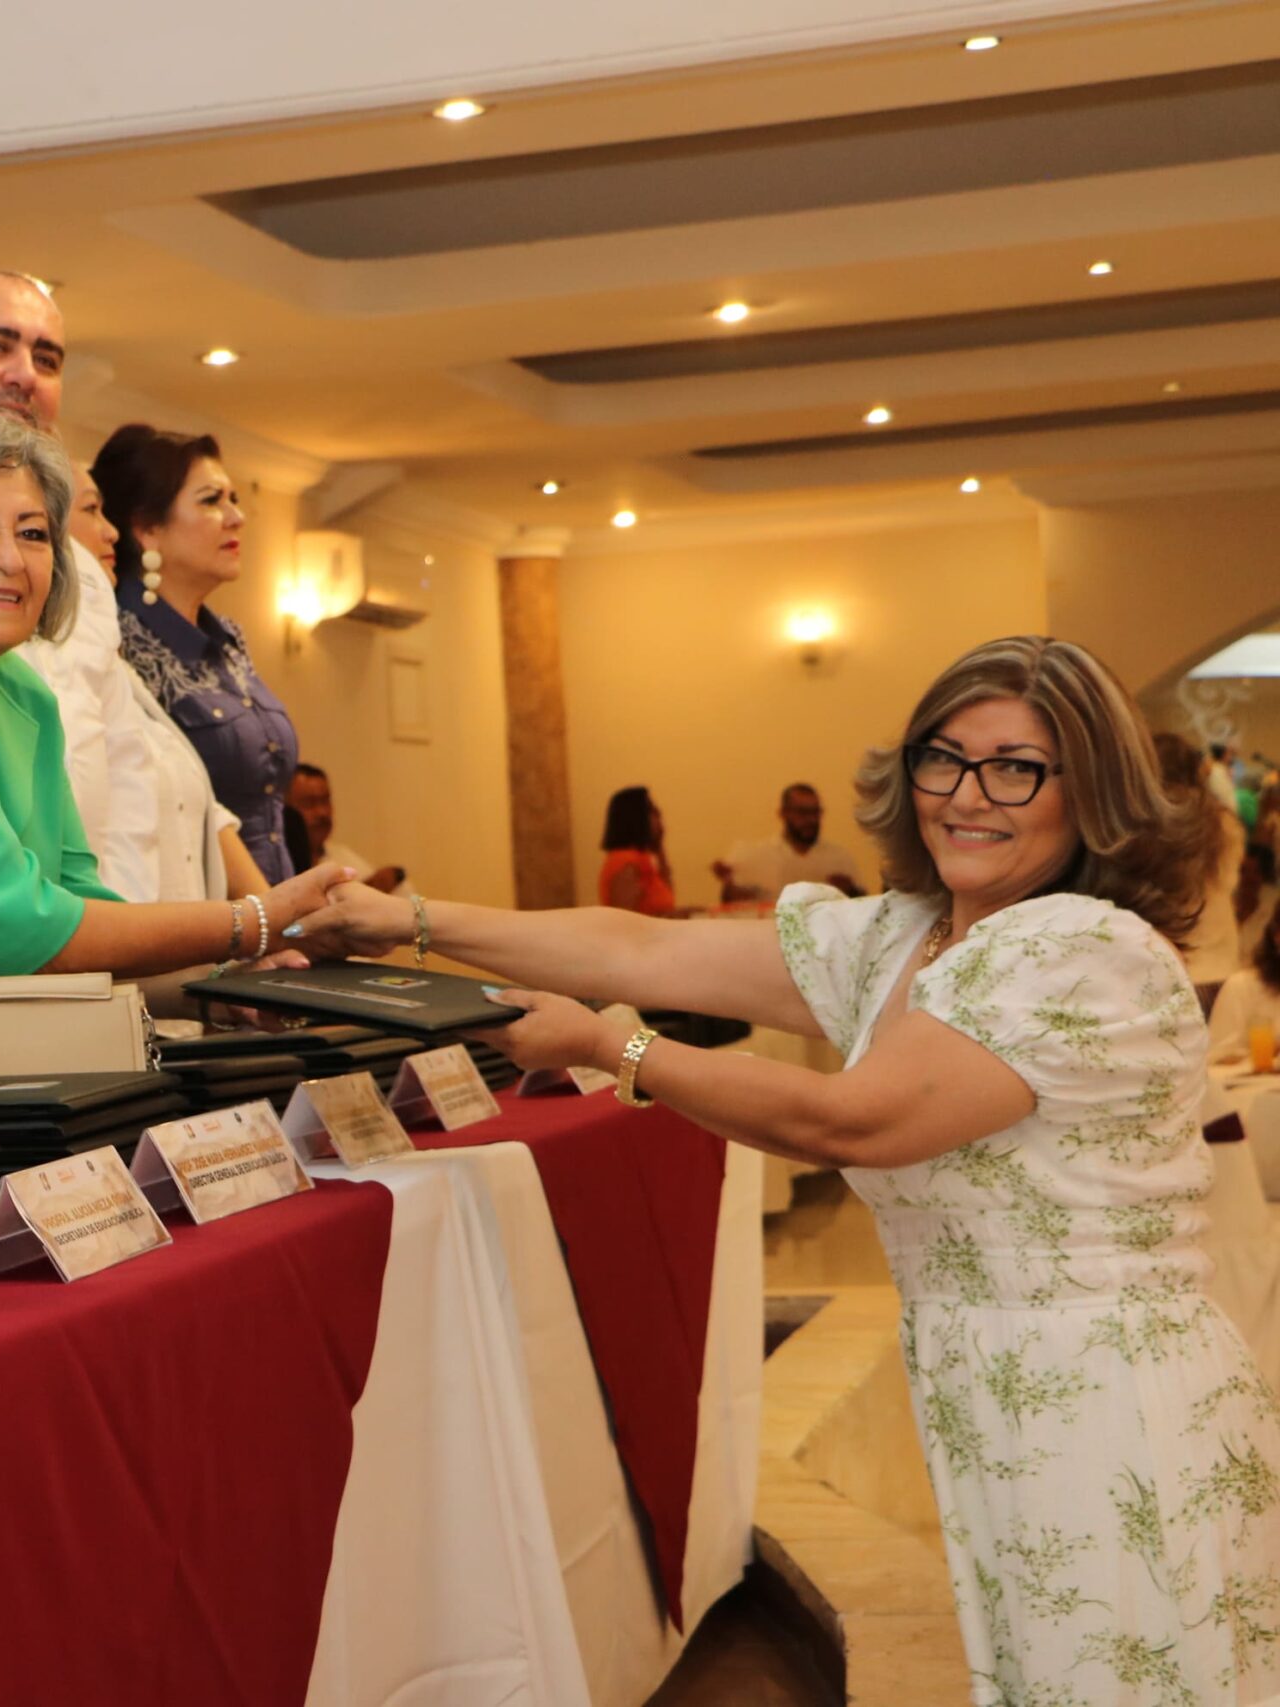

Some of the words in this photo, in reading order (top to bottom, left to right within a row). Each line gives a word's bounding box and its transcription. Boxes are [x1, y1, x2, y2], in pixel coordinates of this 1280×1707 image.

[189, 1172, 216, 1189] DIRECTOR
[213, 1166, 239, 1182] GENERAL
[235, 1164, 246, 1175] DE
[86, 1223, 97, 1234] DE
